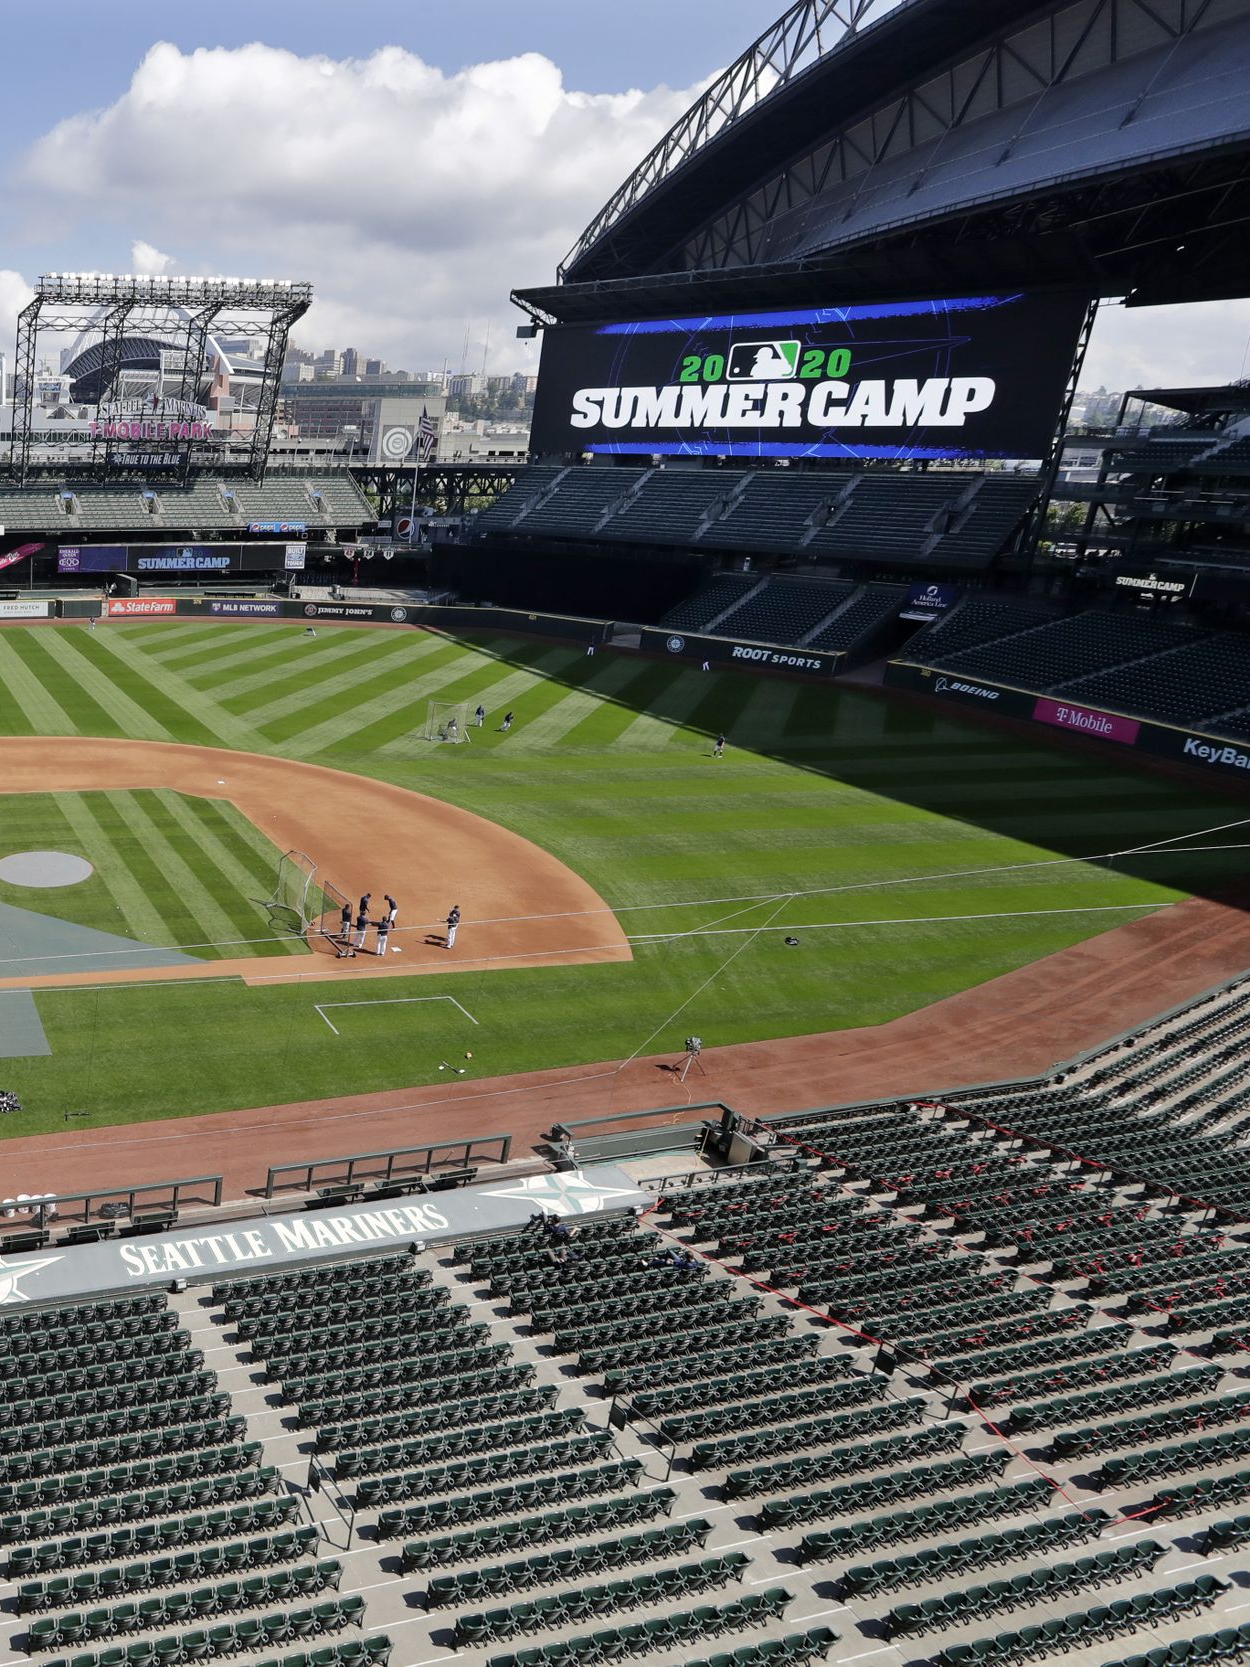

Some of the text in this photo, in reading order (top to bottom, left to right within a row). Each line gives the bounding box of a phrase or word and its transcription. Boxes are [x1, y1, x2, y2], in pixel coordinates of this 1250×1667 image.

[679, 349, 851, 382] 20 20
[570, 377, 996, 428] SUMMER CAMP
[88, 421, 214, 439] T-MOBILE PARK
[121, 453, 181, 464] TRUE TO THE BLUE
[138, 557, 230, 569] SUMMER CAMP
[1115, 576, 1185, 592] SUMMER CAMP
[732, 646, 822, 669] ROOT SPORTS
[950, 682, 1000, 700] BOEING
[120, 1203, 450, 1277] SEATTLE MARINERS
